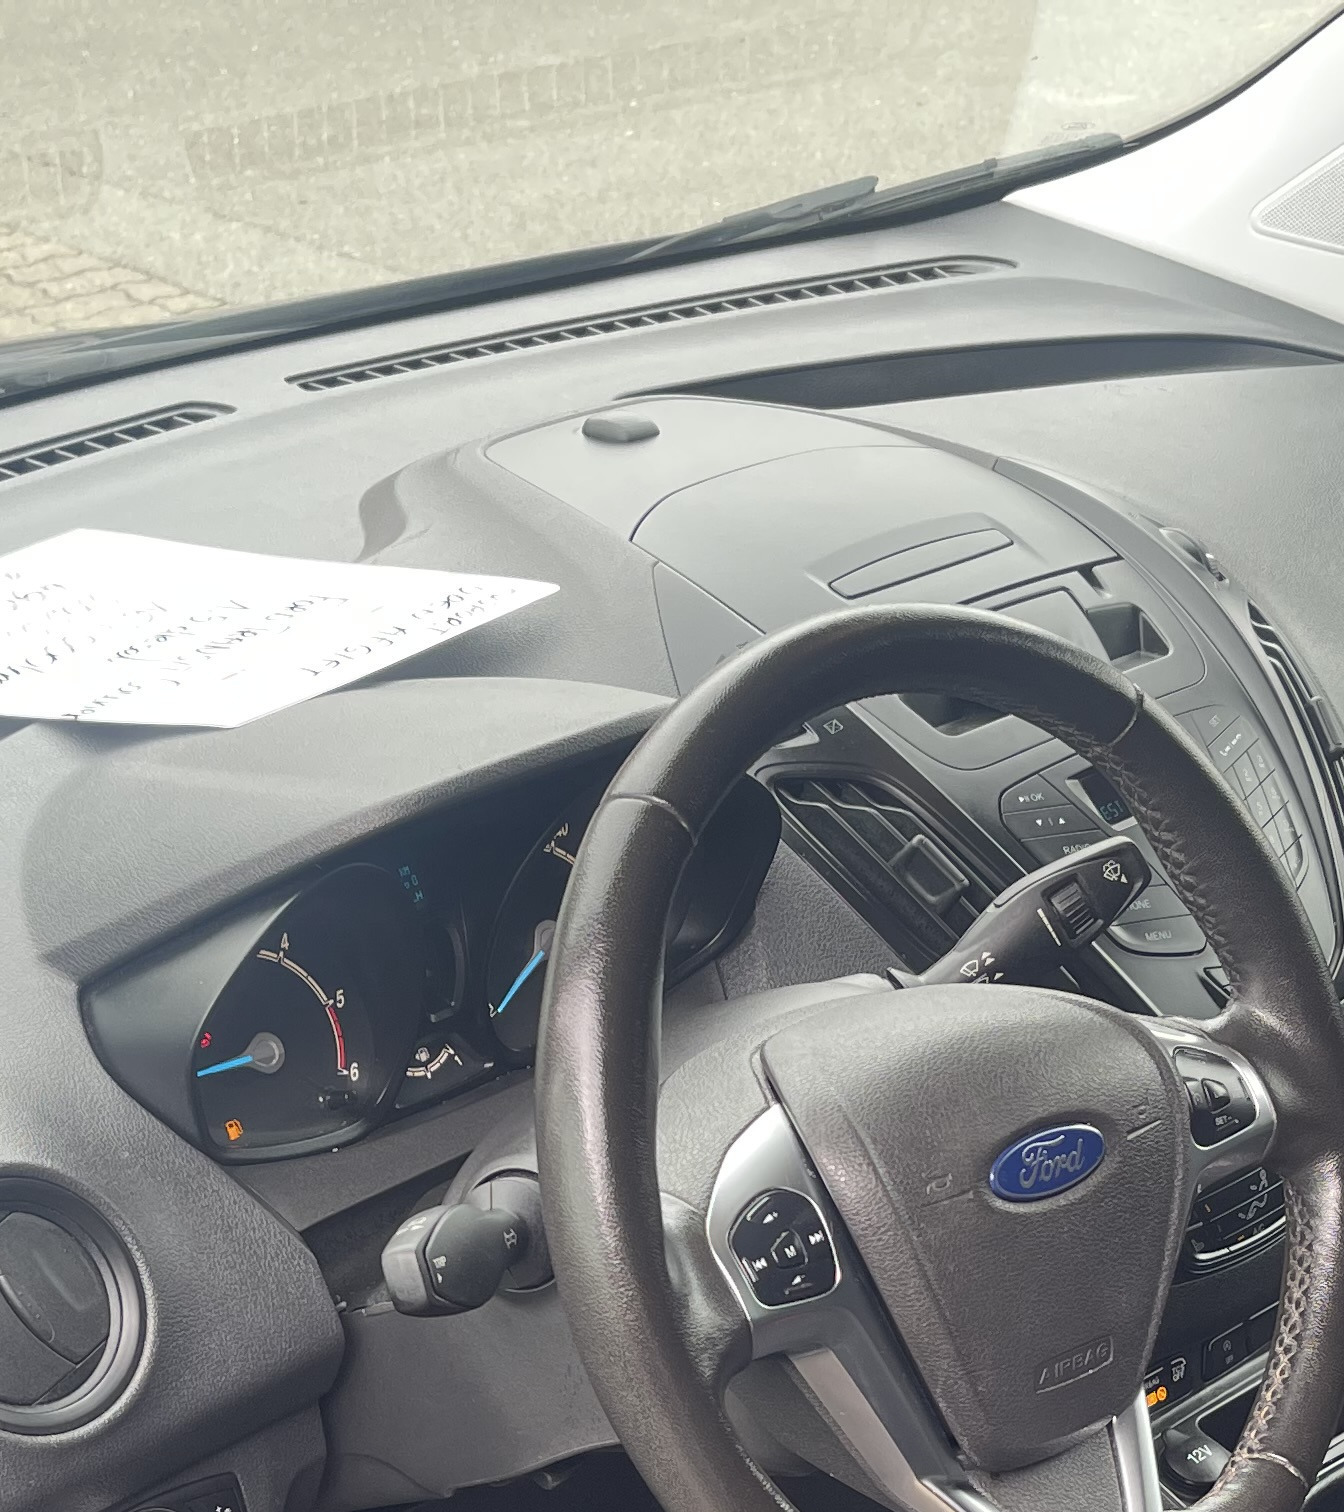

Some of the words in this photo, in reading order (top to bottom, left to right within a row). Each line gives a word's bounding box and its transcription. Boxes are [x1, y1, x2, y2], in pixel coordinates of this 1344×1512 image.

[280, 932, 290, 951] 4
[1144, 928, 1173, 942] MENU
[336, 989, 345, 1009] 5
[350, 1062, 359, 1081] 6
[1019, 1134, 1086, 1190] Ford
[784, 1244, 797, 1259] M
[1038, 1341, 1109, 1386] AIRBAG
[1187, 1444, 1213, 1464] 12V
